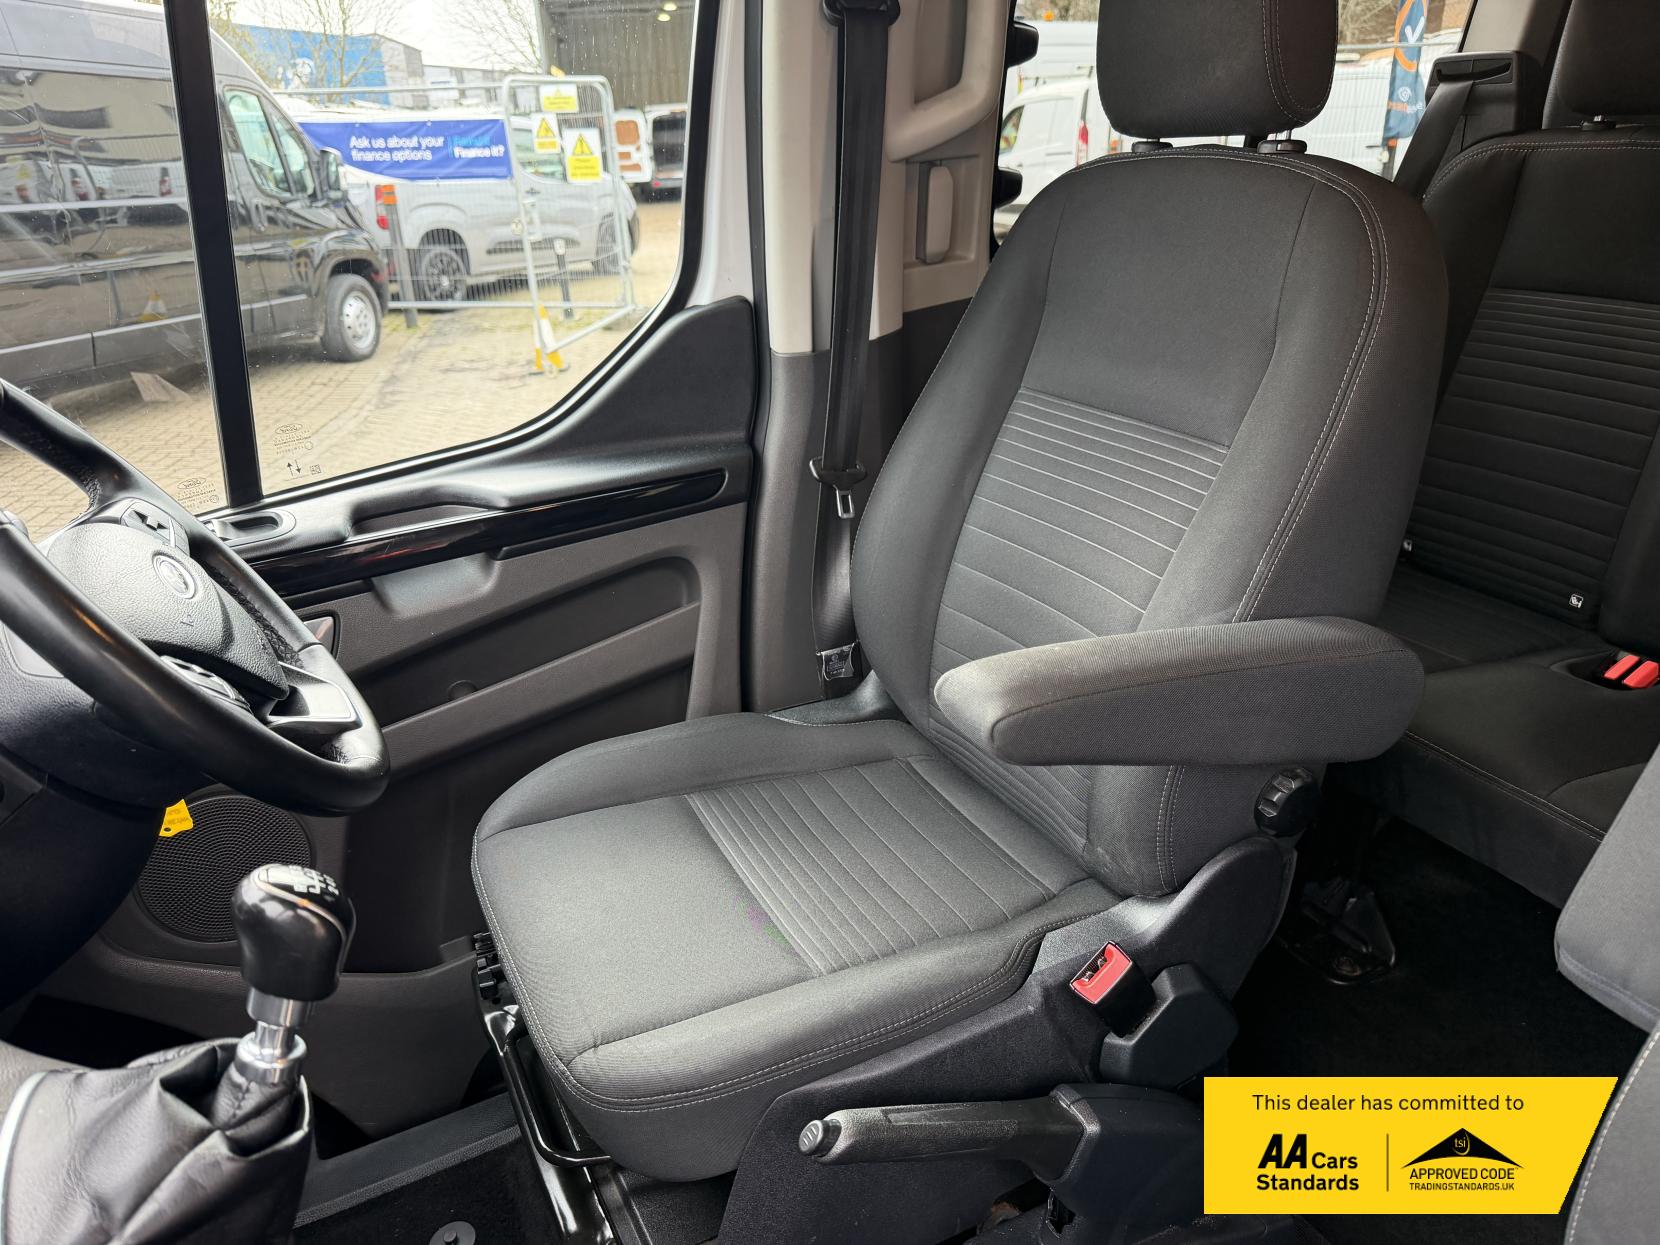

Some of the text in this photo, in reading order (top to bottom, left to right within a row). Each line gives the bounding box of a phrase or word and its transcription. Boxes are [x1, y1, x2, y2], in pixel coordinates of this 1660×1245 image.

[350, 135, 371, 149] Ask
[371, 137, 386, 149] us
[386, 134, 419, 149] about
[419, 136, 445, 150] your
[351, 149, 433, 163] finance options
